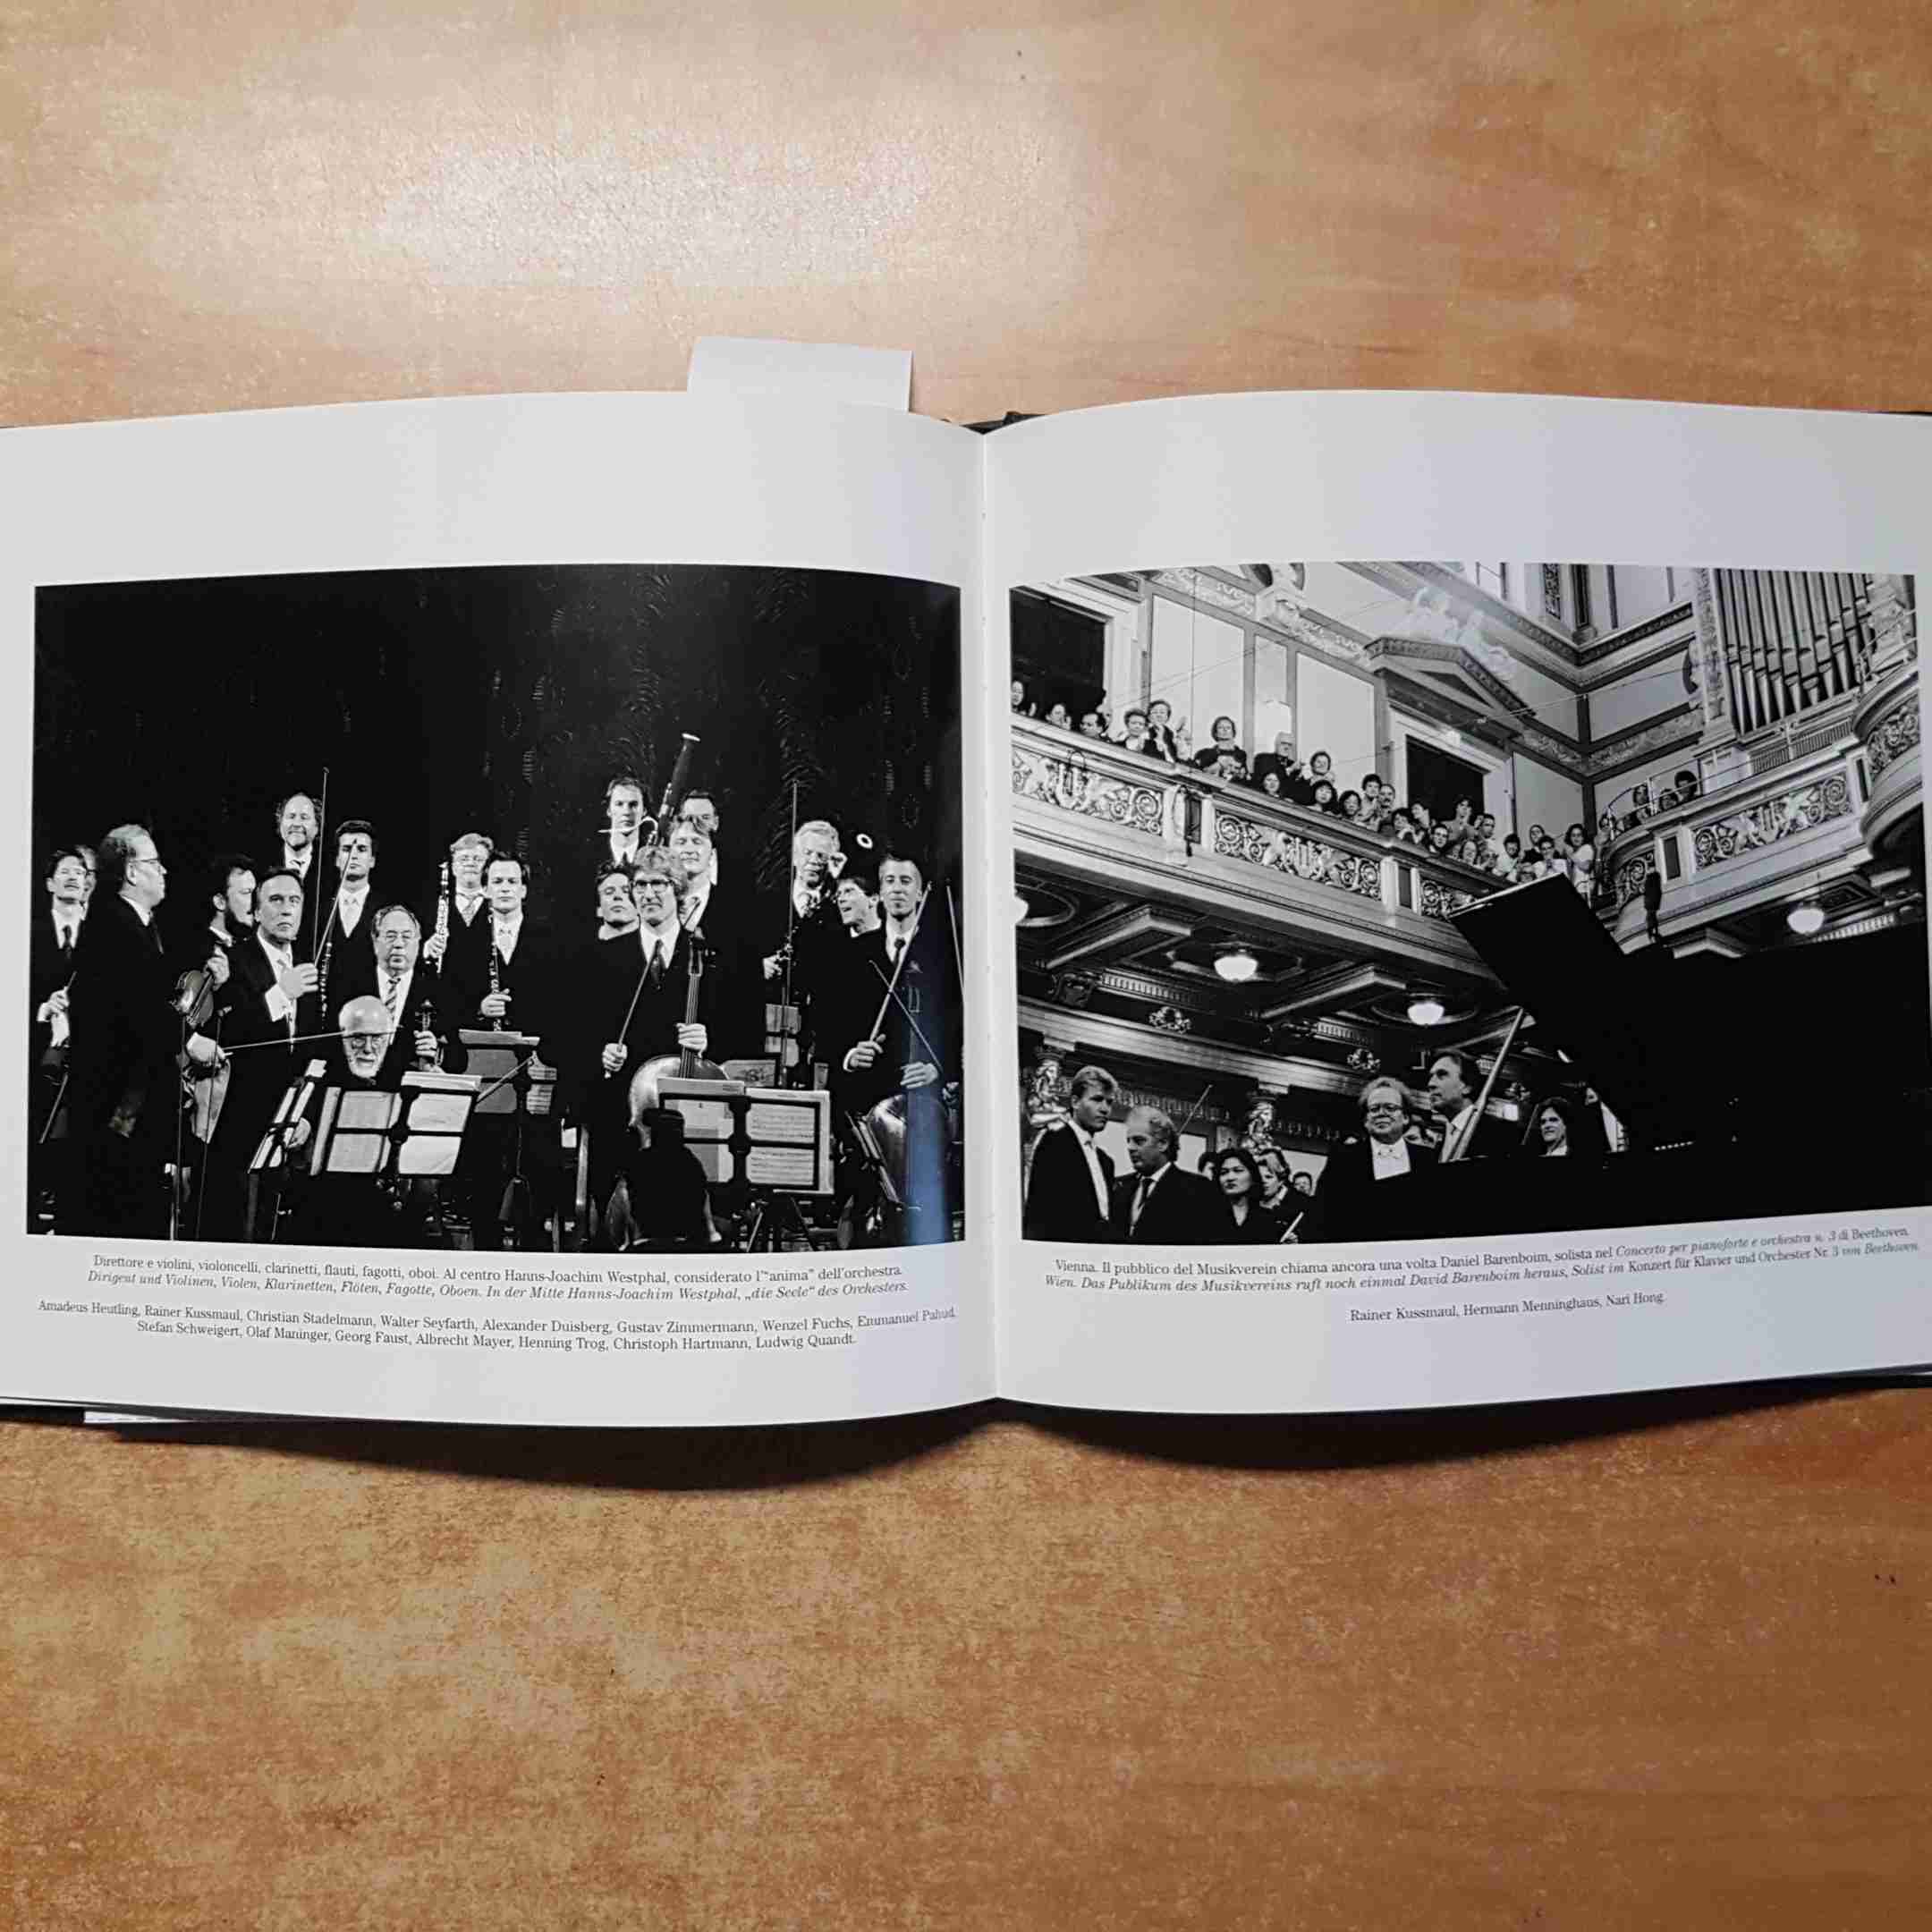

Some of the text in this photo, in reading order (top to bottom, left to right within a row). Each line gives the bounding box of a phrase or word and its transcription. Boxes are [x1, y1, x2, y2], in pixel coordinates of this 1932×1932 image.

[94, 1254, 143, 1267] Direttore
[157, 1257, 195, 1272] violini,
[199, 1259, 261, 1274] violoncelli,
[265, 1262, 321, 1277] clarinetti,
[324, 1265, 359, 1278] flauti,
[362, 1266, 404, 1280] fagotti,
[444, 1268, 456, 1279] Al
[461, 1270, 501, 1281] centro
[504, 1269, 603, 1283] Hanns-Joachim
[607, 1271, 670, 1285] Westphal,
[674, 1272, 751, 1283] considerato
[1081, 1276, 1105, 1289] Das
[1109, 1278, 1171, 1291] Publikum
[1176, 1280, 1197, 1292] des
[1202, 1280, 1292, 1291] Musikvereins
[1296, 1278, 1321, 1292] ruft
[1326, 1277, 1355, 1289] noch
[1360, 1275, 1406, 1288] einmal
[1410, 1273, 1448, 1286] David
[1452, 1270, 1519, 1282] Barenboim
[1524, 1267, 1568, 1280] heraus,
[1572, 1265, 1605, 1276] Solist
[1609, 1264, 1624, 1274] im
[1629, 1260, 1672, 1272] Konzert
[1694, 1255, 1732, 1267] Klavier
[1735, 1253, 1756, 1264] und
[1758, 1249, 1810, 1263] Orchester
[1102, 1261, 1110, 1273] Il
[1114, 1262, 1169, 1275] pubblico
[1174, 1263, 1193, 1275] del
[1197, 1263, 1276, 1275] Musikverein
[1281, 1261, 1327, 1275] chiama
[1332, 1261, 1375, 1273] ancora
[1379, 1260, 1402, 1271] una
[1405, 1258, 1436, 1269] volta
[1441, 1255, 1479, 1267] Daniel
[1484, 1253, 1551, 1265] Barenboim,
[1555, 1249, 1592, 1261] solista
[1596, 1247, 1612, 1258] nel
[1616, 1245, 1665, 1257] Concerto
[1670, 1243, 1688, 1255] per
[1691, 1238, 1748, 1252] pianoforte
[1760, 1234, 1810, 1246] orchestra
[89, 1270, 135, 1284] Dirigent
[140, 1275, 162, 1284] und
[166, 1274, 216, 1289] Violinen,
[222, 1275, 260, 1291] Violen,
[265, 1278, 336, 1294] Klarinetten,
[386, 1282, 436, 1298] Fagotte,
[439, 1284, 481, 1297] Oboen.
[487, 1285, 500, 1298] In
[504, 1287, 526, 1298] der
[530, 1287, 564, 1299] Mitte
[568, 1288, 674, 1300] Hanns-Joachim
[679, 1288, 741, 1301] Westphal,
[818, 1284, 838, 1296] des
[38, 1300, 88, 1313] Amadeus
[145, 1305, 182, 1318] Rainer
[185, 1307, 243, 1322] Kussmaul,
[247, 1309, 299, 1324] Christian
[303, 1313, 376, 1327] Stadelmann,
[380, 1315, 419, 1328] Walter
[423, 1317, 479, 1332] Seyfarth,
[483, 1320, 547, 1332] Alexander
[551, 1320, 613, 1335] Duisberg,
[617, 1321, 664, 1334] Gustav
[666, 1321, 758, 1333] Zimmermann,
[763, 1318, 807, 1332] Wenzel
[811, 1317, 853, 1331] Fuchs,
[858, 1309, 919, 1326] Emmanuel
[1351, 1309, 1392, 1321] Rainer
[1396, 1306, 1460, 1319] Kussmaul,
[1463, 1303, 1518, 1314] Hermann
[137, 1320, 173, 1333] Stefan
[176, 1322, 242, 1338] Schweigert,
[246, 1326, 271, 1339] Olaf
[275, 1327, 331, 1343] Maninger,
[335, 1329, 371, 1344] Georg
[376, 1332, 411, 1345] Faust,
[416, 1334, 469, 1346] Albrecht
[473, 1335, 513, 1350] Mayer,
[519, 1336, 572, 1351] Henning
[576, 1337, 609, 1352] Trog,
[614, 1338, 678, 1352] Christoph
[682, 1338, 751, 1350] Hartmann,
[756, 1335, 803, 1351] Ludwig
